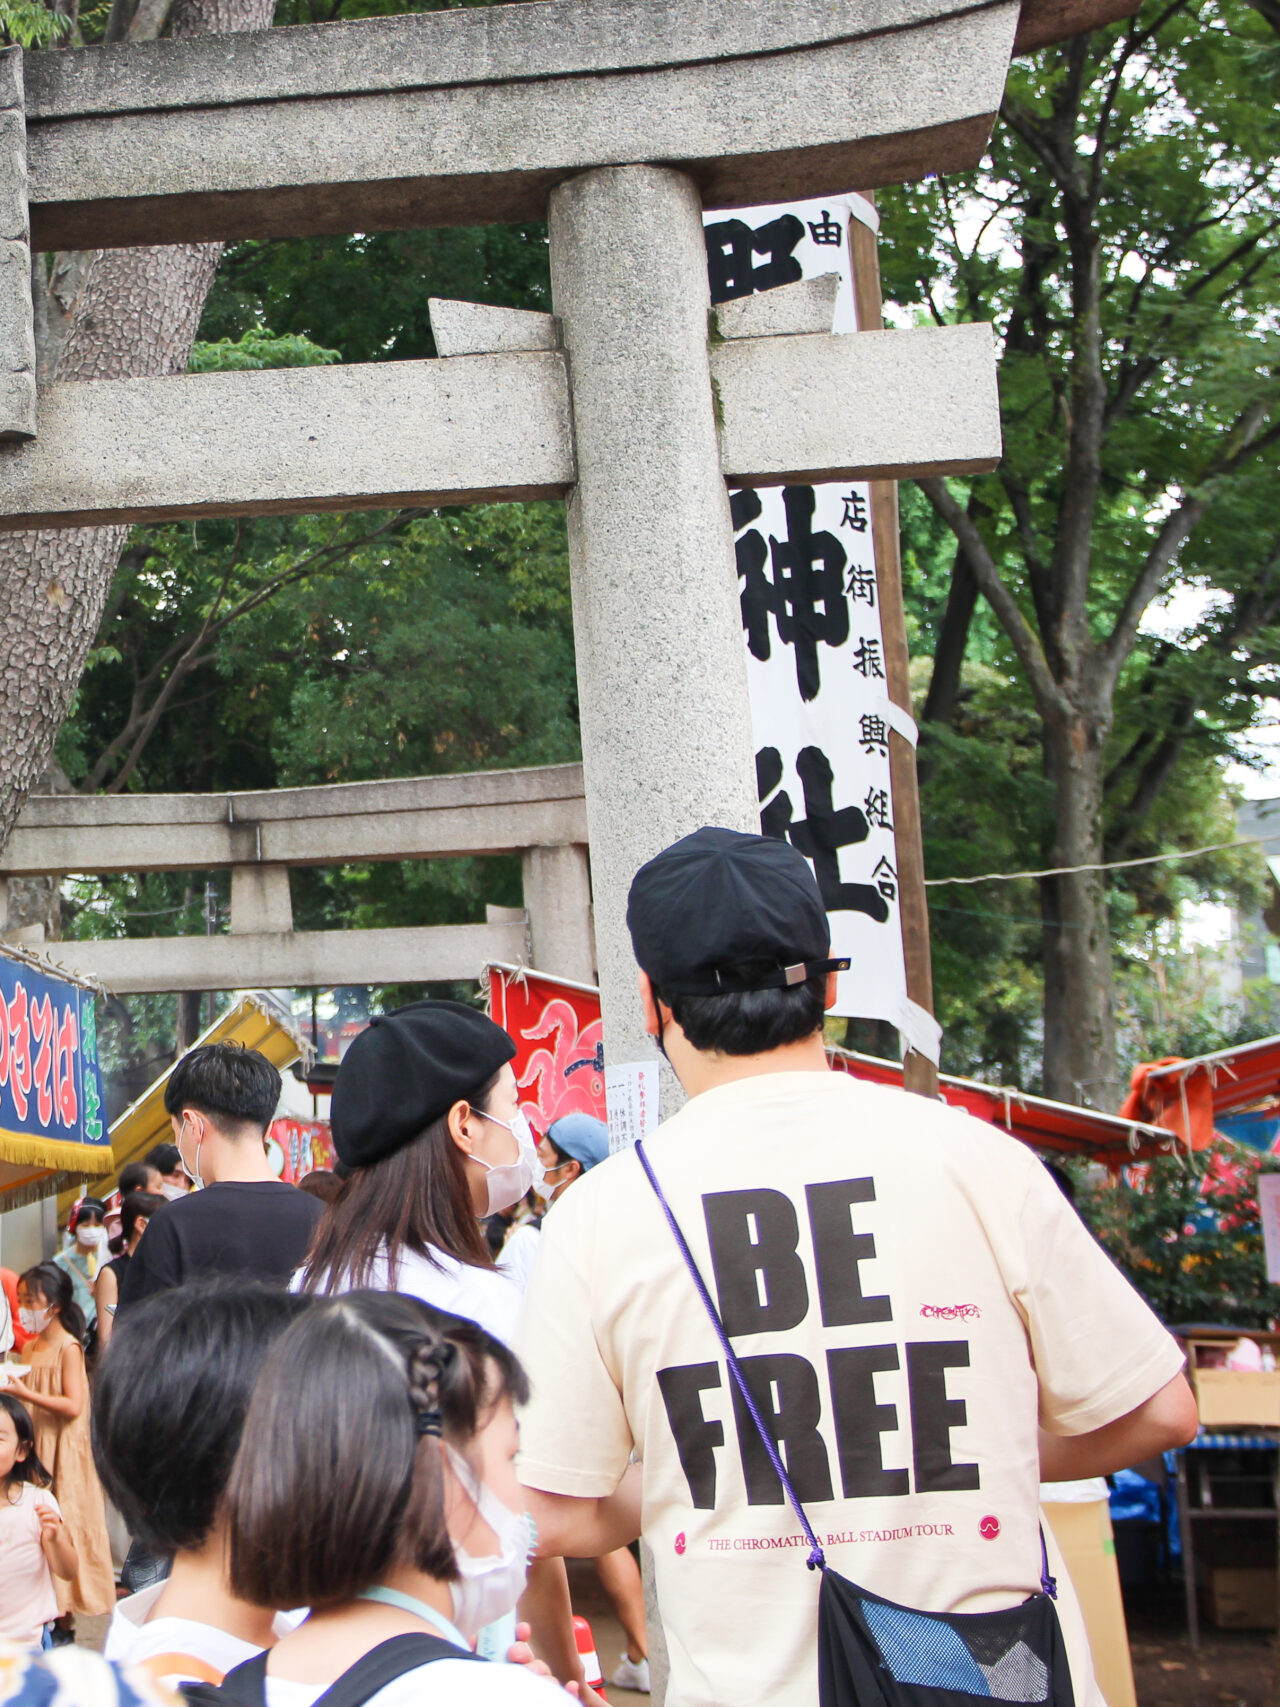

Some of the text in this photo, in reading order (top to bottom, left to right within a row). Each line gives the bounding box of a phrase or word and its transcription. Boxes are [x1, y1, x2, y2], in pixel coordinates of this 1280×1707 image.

[701, 1176, 893, 1338] BE
[656, 1340, 980, 1510] FREE
[707, 1539, 731, 1551] THE
[827, 1530, 859, 1546] BALL
[860, 1525, 914, 1542] STADIUM
[915, 1523, 955, 1537] TOUR
